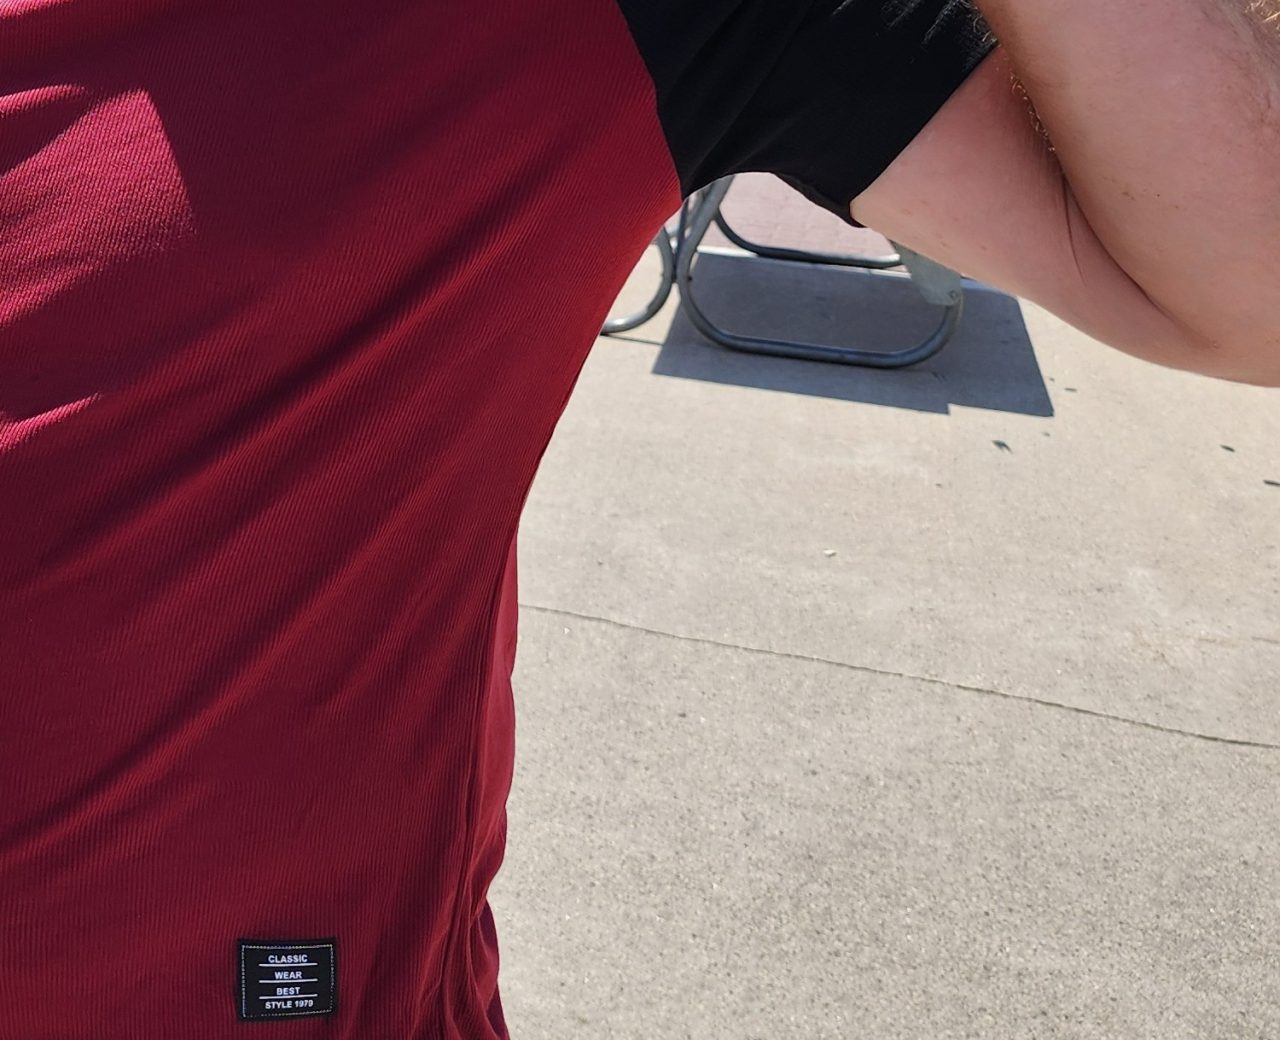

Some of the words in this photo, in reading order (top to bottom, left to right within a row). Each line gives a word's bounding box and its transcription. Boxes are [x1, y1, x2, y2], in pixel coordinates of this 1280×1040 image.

[268, 954, 308, 964] CLASSIC
[274, 971, 303, 980] WEAR
[276, 986, 301, 996] BEST
[265, 1001, 293, 1010] STYLE
